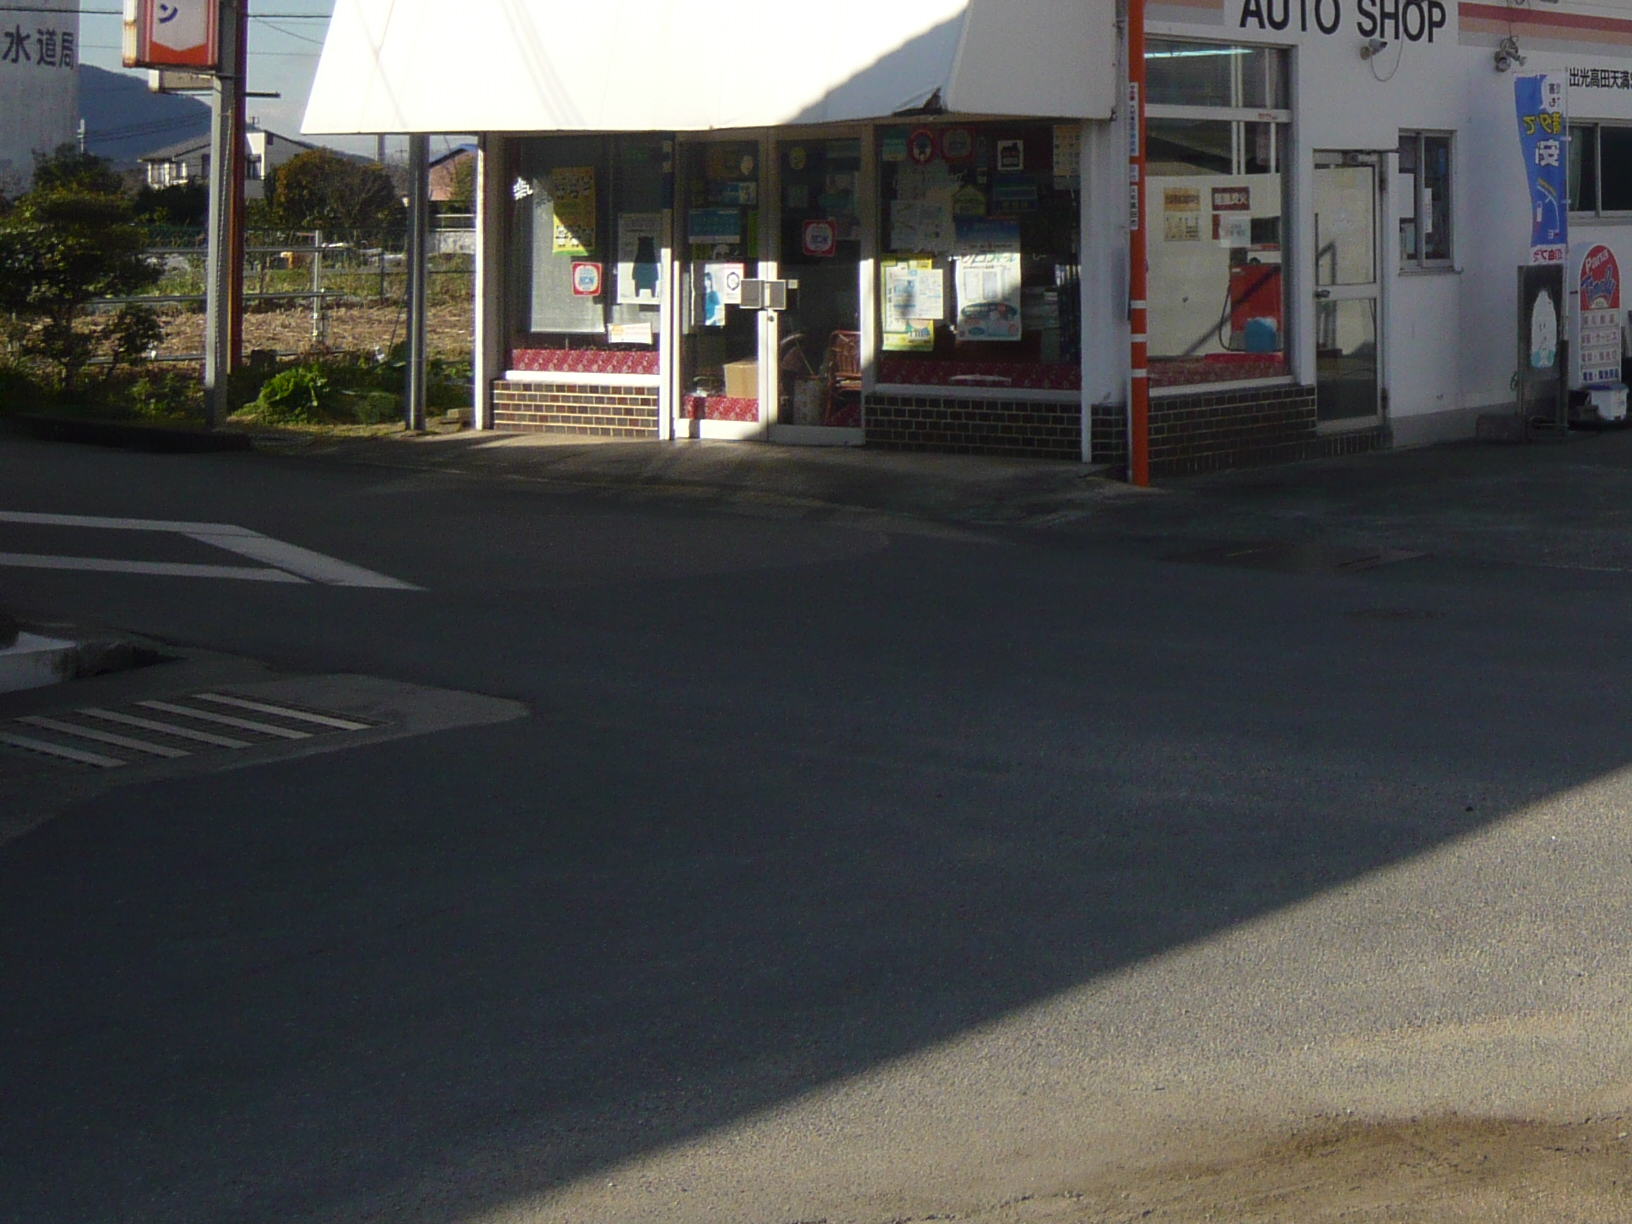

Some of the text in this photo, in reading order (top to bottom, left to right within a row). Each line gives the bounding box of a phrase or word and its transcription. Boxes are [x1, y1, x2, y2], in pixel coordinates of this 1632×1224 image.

[2, 24, 75, 70] 水道局
[1585, 248, 1609, 274] Pana
